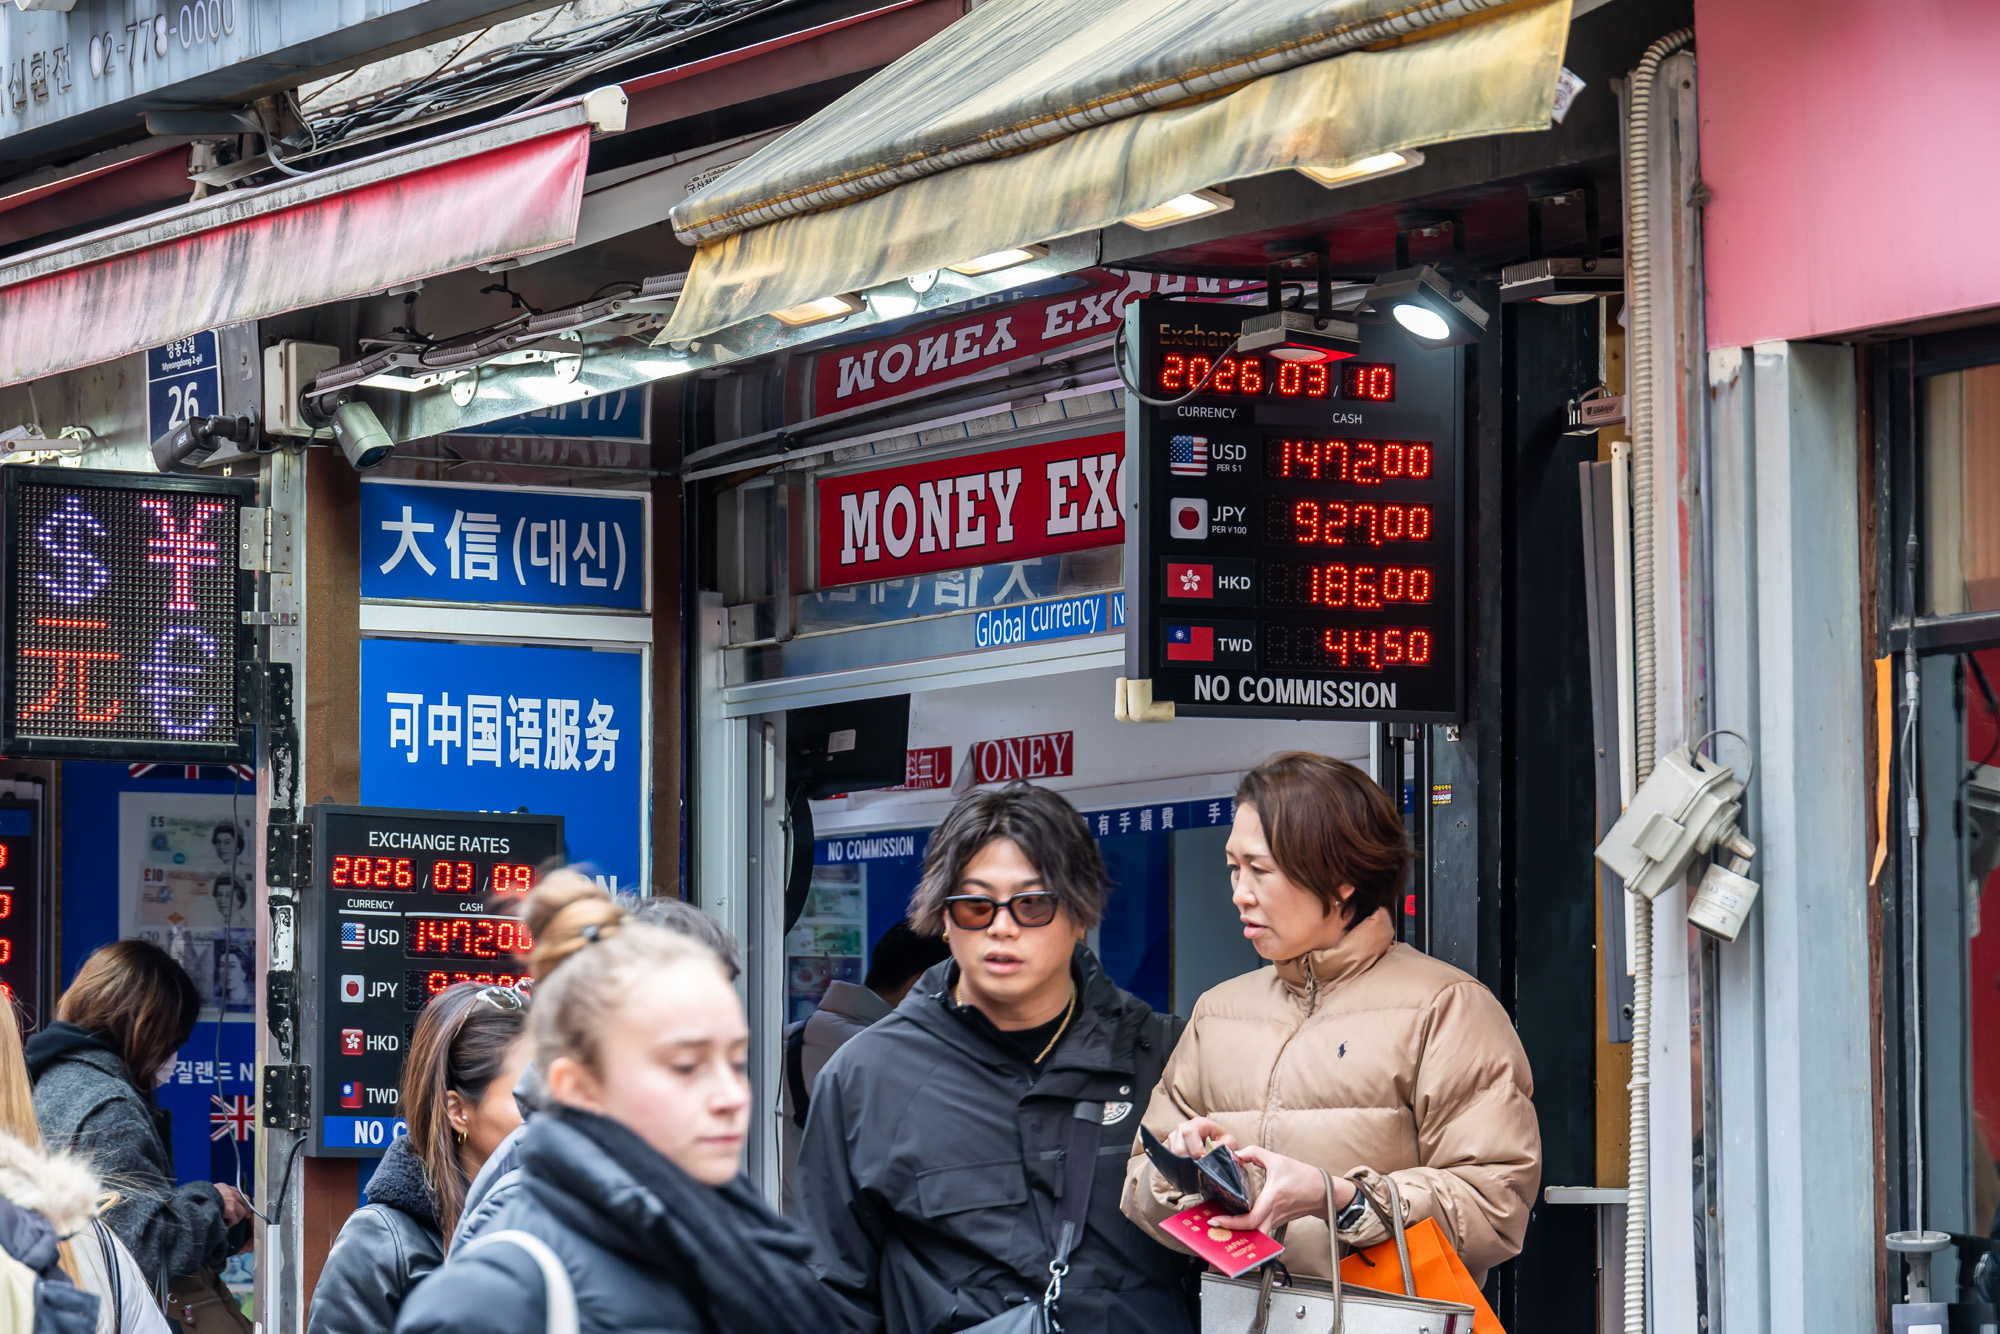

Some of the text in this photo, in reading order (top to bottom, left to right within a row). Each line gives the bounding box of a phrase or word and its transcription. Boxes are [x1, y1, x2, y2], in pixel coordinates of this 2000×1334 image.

[161, 353, 203, 373] Myeongdong 2-gil
[168, 381, 199, 431] 26
[1177, 405, 1362, 425] CURRENCY CASH
[1212, 444, 1247, 461] USD
[1216, 463, 1230, 473] PER
[840, 452, 1125, 566] MONEY EX
[1212, 506, 1247, 523] JPY
[1211, 525, 1226, 534] PER
[1218, 575, 1251, 590] HKD
[976, 597, 1100, 648] Global currency
[1218, 638, 1253, 653] TWD
[1194, 674, 1397, 708] NO COMMISSION
[386, 692, 620, 772] 可中国语服务
[975, 733, 1071, 782] ONEY
[368, 831, 510, 854] EXCHANGE RATES
[828, 836, 914, 861] NO COMMISSION
[347, 898, 484, 912] CURRENCY CASH
[368, 929, 399, 945] USD
[367, 982, 398, 998] JPY
[366, 1035, 399, 1051] HKD
[166, 1060, 234, 1084] 질랜드
[366, 1088, 399, 1105] TWD
[354, 1120, 384, 1145] NO
